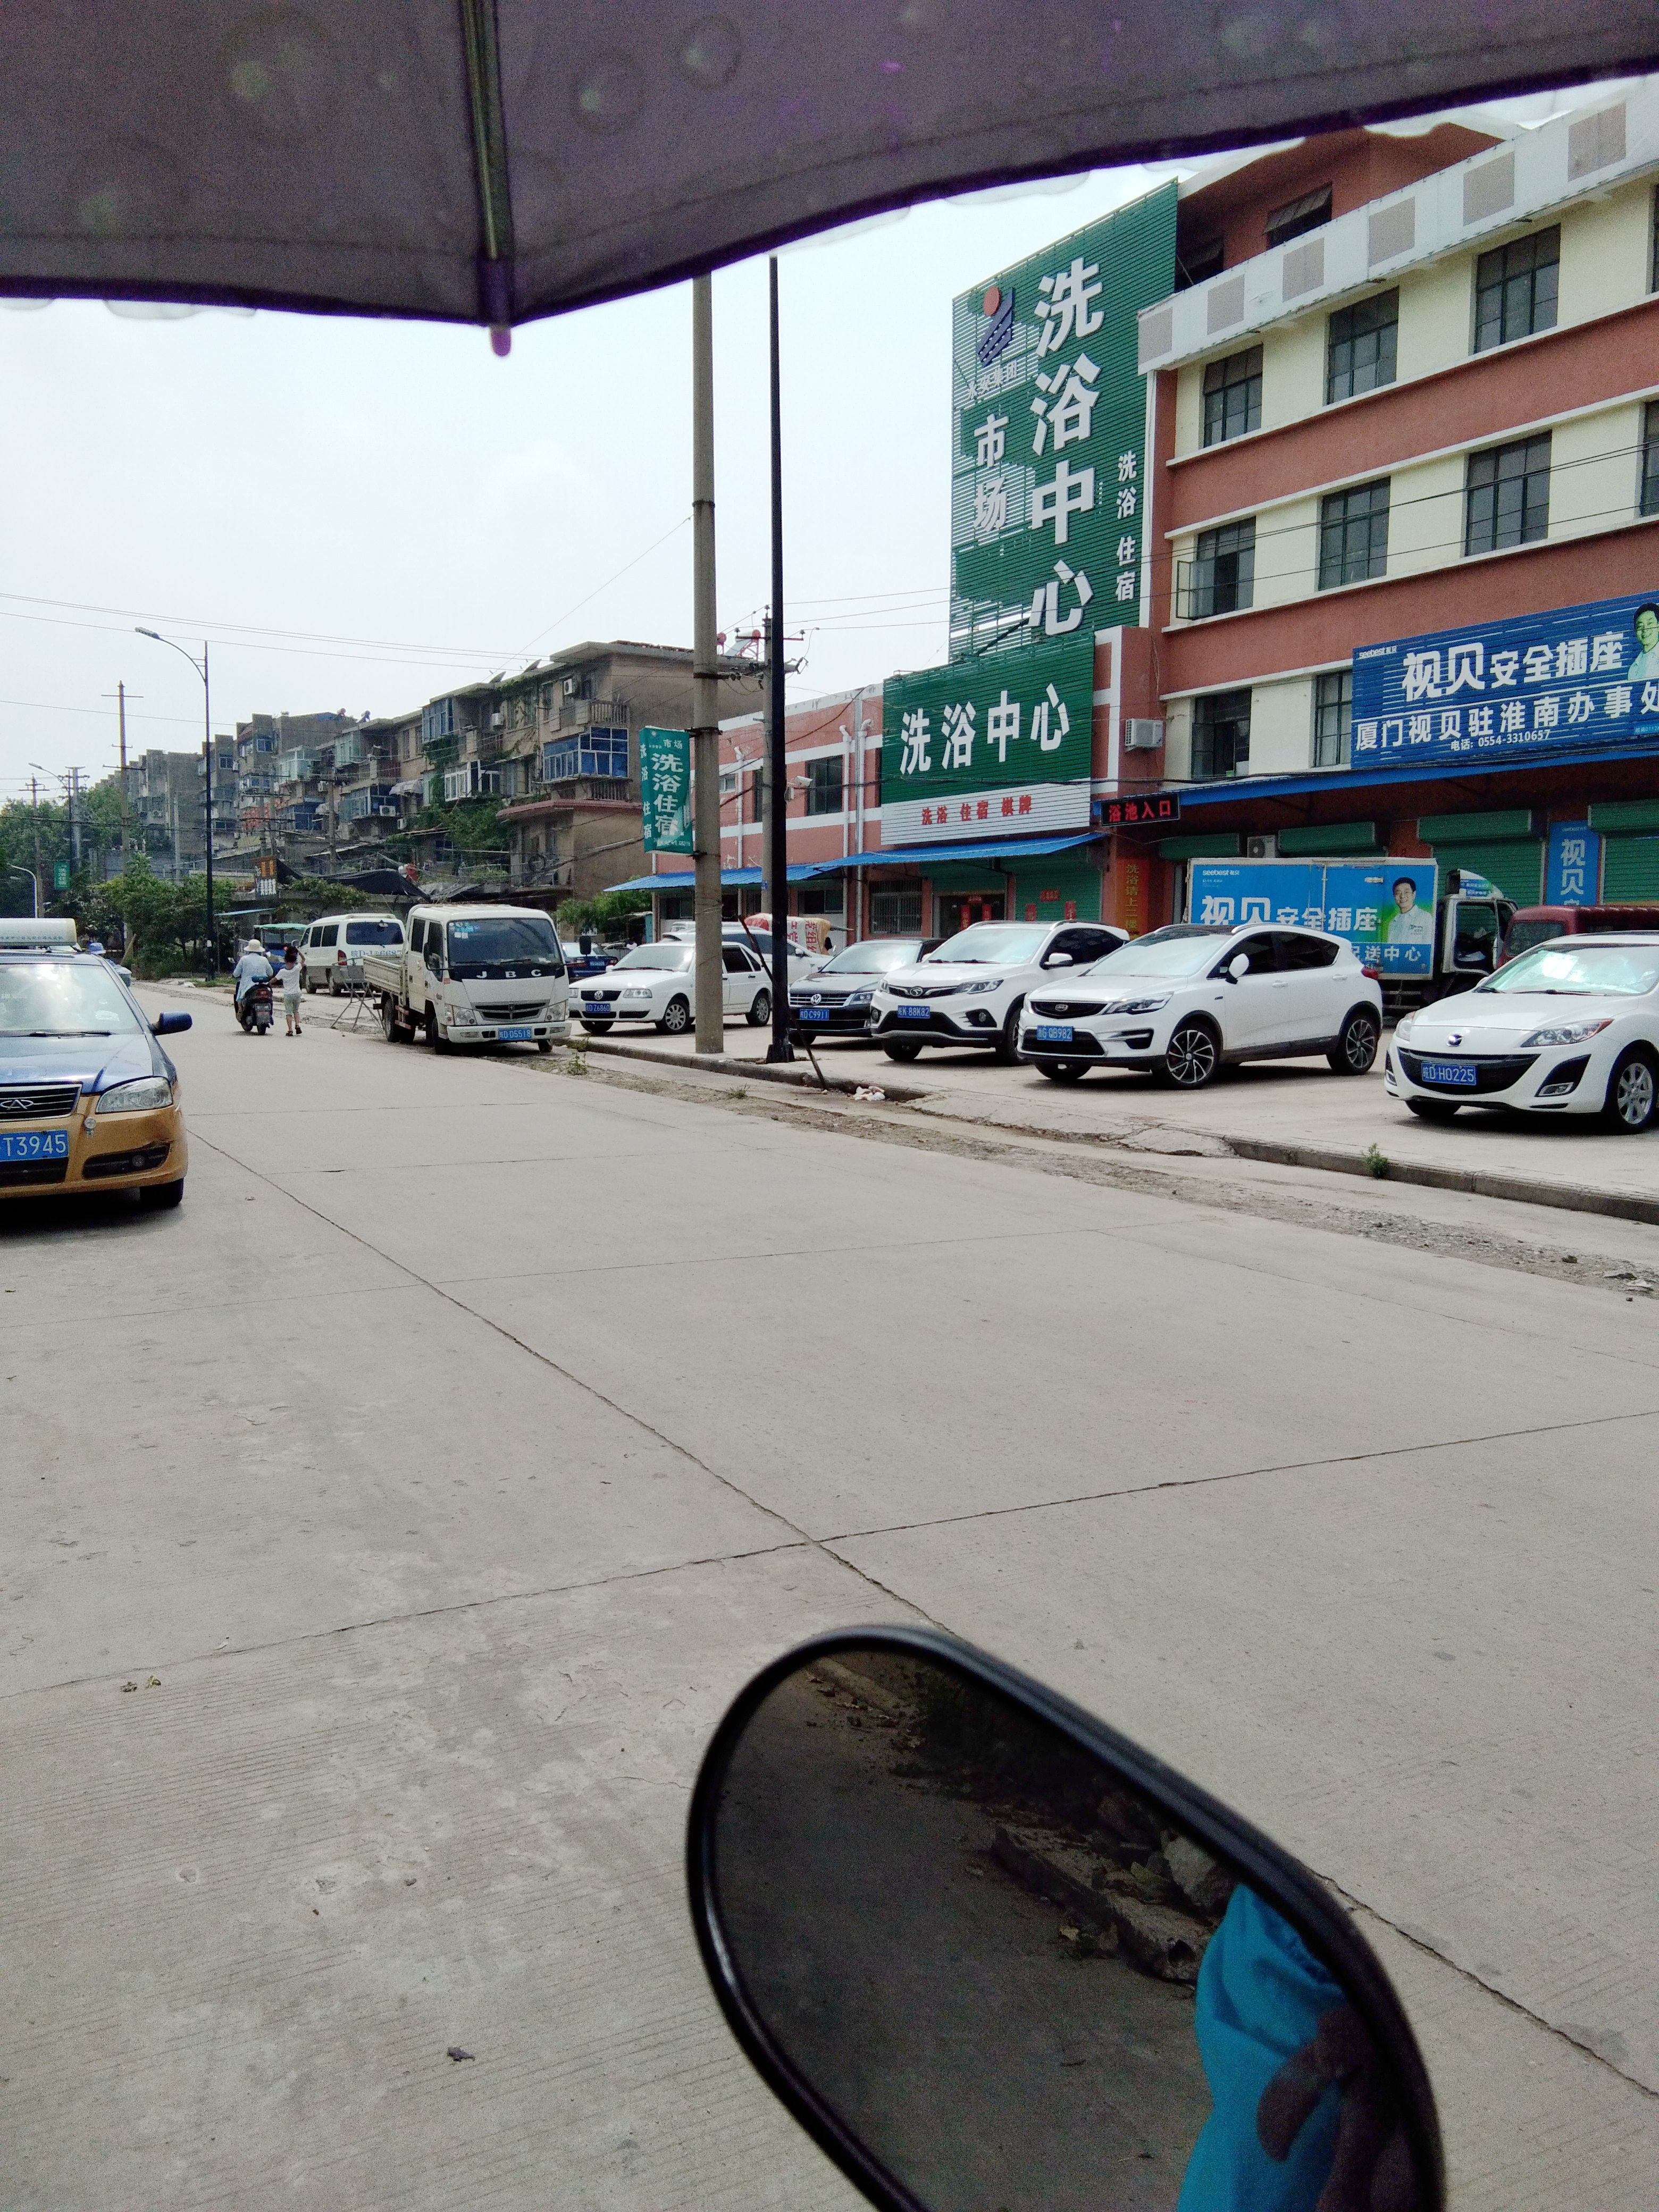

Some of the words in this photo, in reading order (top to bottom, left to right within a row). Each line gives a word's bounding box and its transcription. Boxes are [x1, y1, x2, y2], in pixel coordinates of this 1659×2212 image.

[968, 360, 1017, 400] 永安集团
[973, 413, 1009, 532] 市场
[1028, 257, 1104, 636] 洗浴中心
[1117, 450, 1137, 520] 洗浴
[1116, 536, 1137, 601] 住宿
[1402, 631, 1624, 702] 视贝安全插座
[663, 739, 683, 749] 市场
[900, 683, 1069, 774] 洗浴中心
[1356, 682, 1659, 750] 厦门视贝驻淮南办事处
[1478, 729, 1551, 747] 0554-3310657
[651, 752, 684, 836] 洗浴住宿
[922, 806, 947, 825] 洗浴
[960, 800, 988, 822] 住宿
[1001, 795, 1032, 817] 棋牌
[1109, 800, 1171, 823] 浴池入口
[1200, 895, 1379, 931] 视贝安全插座
[3, 1134, 66, 1157] T3945
